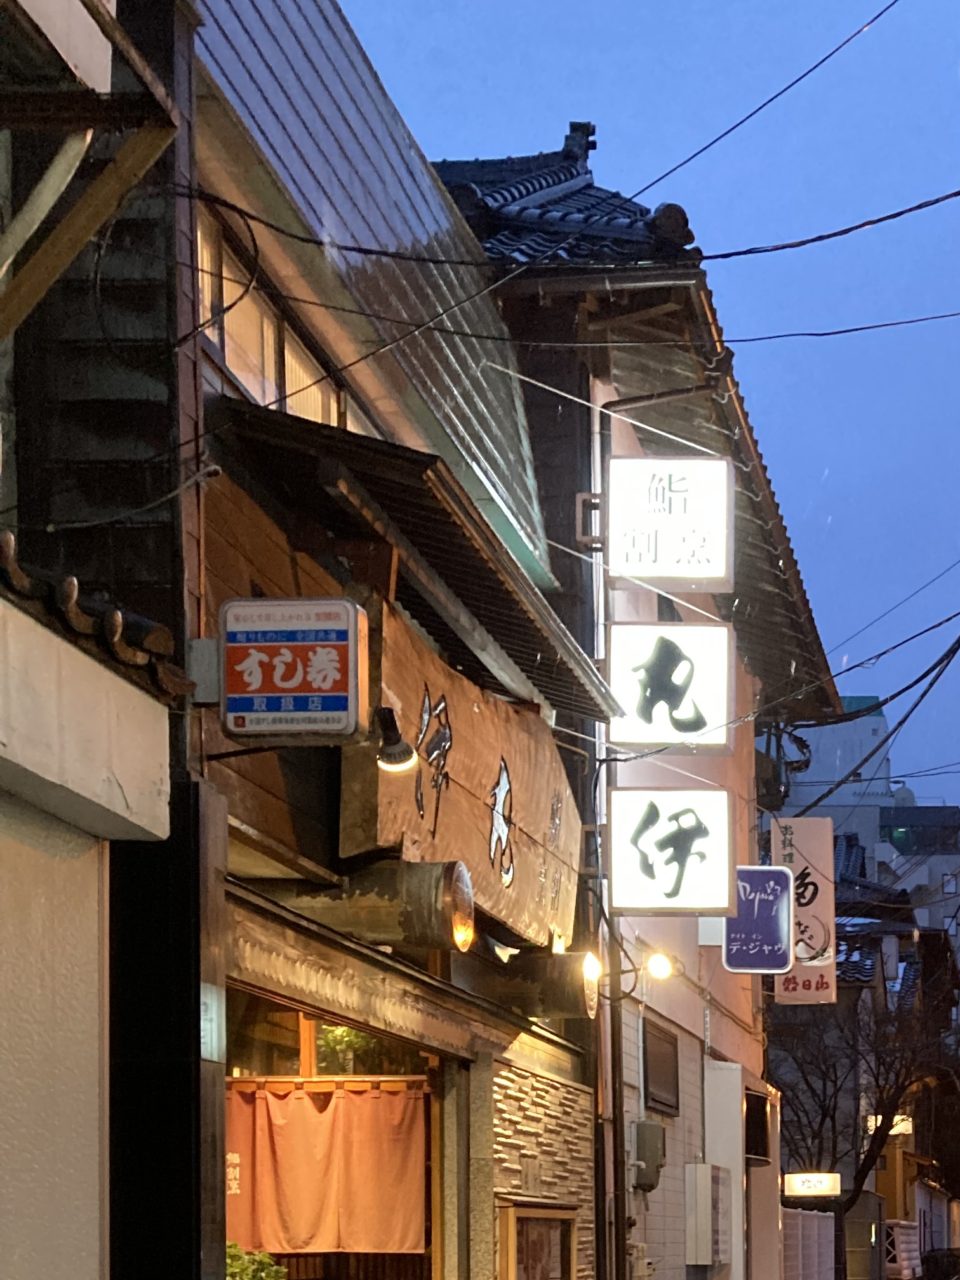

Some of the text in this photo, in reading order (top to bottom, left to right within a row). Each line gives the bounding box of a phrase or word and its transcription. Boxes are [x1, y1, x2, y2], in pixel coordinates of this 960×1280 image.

[648, 473, 688, 514] 鮨
[234, 646, 342, 691] すし券
[253, 696, 322, 711] 取扱店
[630, 800, 710, 899] 伊
